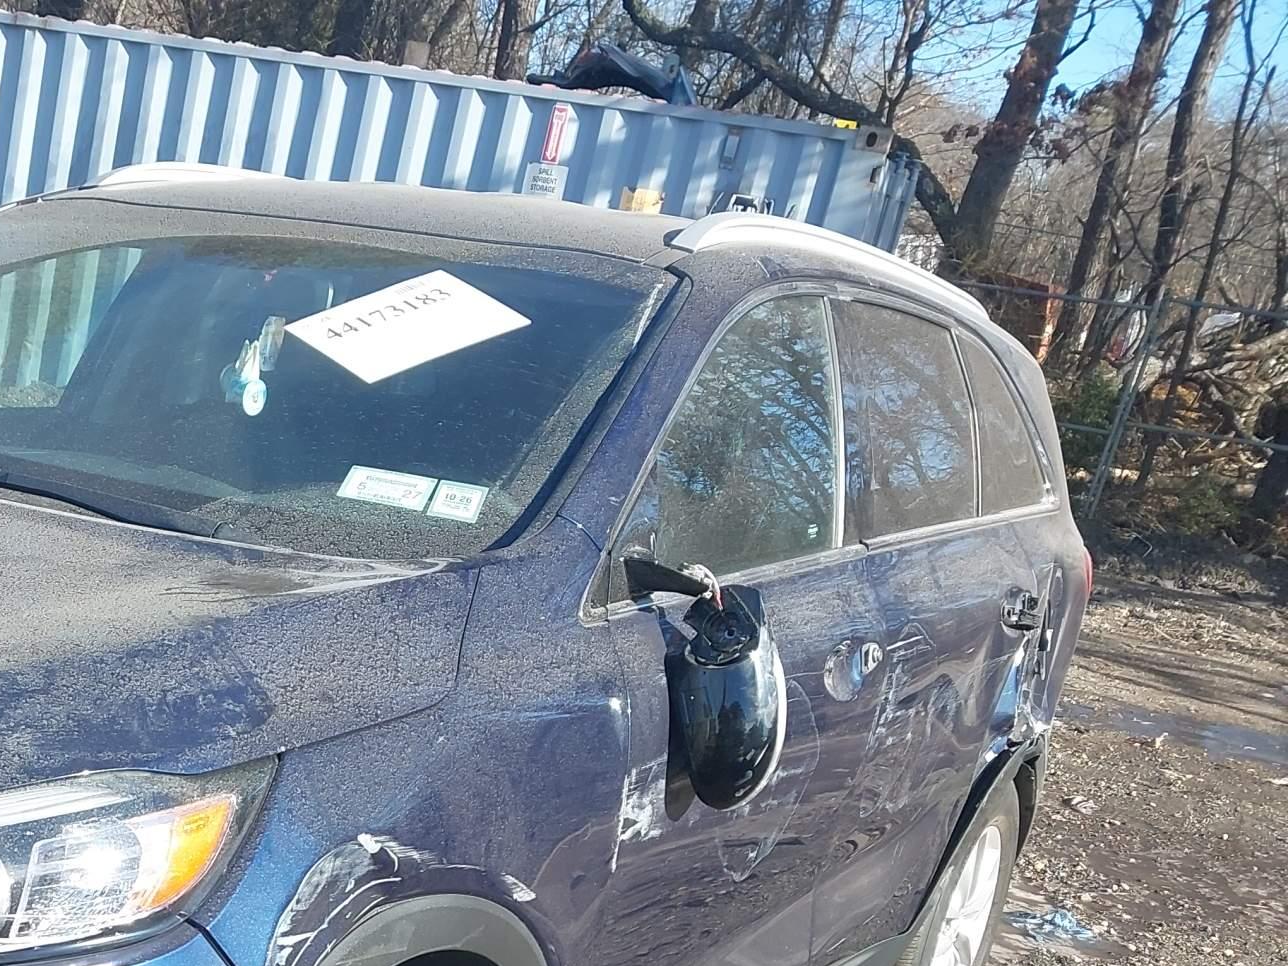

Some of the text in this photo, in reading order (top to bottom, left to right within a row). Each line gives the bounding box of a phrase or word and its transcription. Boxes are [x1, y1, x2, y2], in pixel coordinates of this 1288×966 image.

[538, 167, 553, 176] SPILL
[530, 184, 555, 193] STORAGE
[325, 288, 452, 341] 44173183
